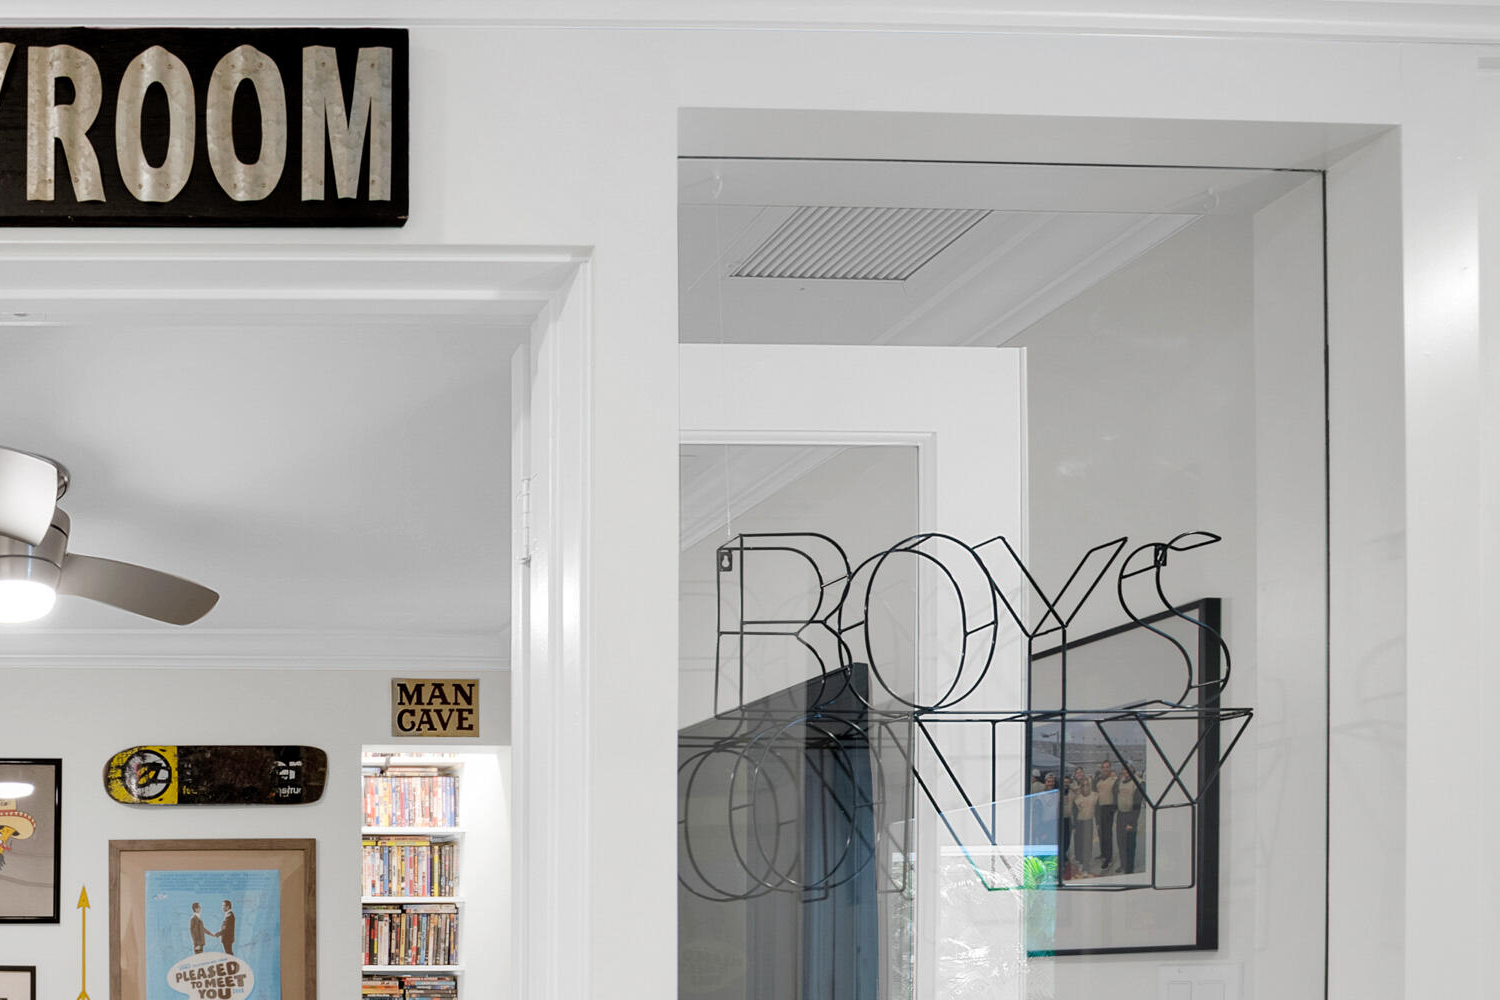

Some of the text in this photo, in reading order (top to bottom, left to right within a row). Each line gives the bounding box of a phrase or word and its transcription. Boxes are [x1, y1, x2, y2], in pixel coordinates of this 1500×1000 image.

[714, 531, 1231, 720] BOYS
[396, 682, 476, 706] MAN
[396, 708, 474, 732] CAVE
[175, 961, 240, 983] PLEASED
[190, 974, 247, 989] TO MEET
[198, 988, 231, 1000] YOU
